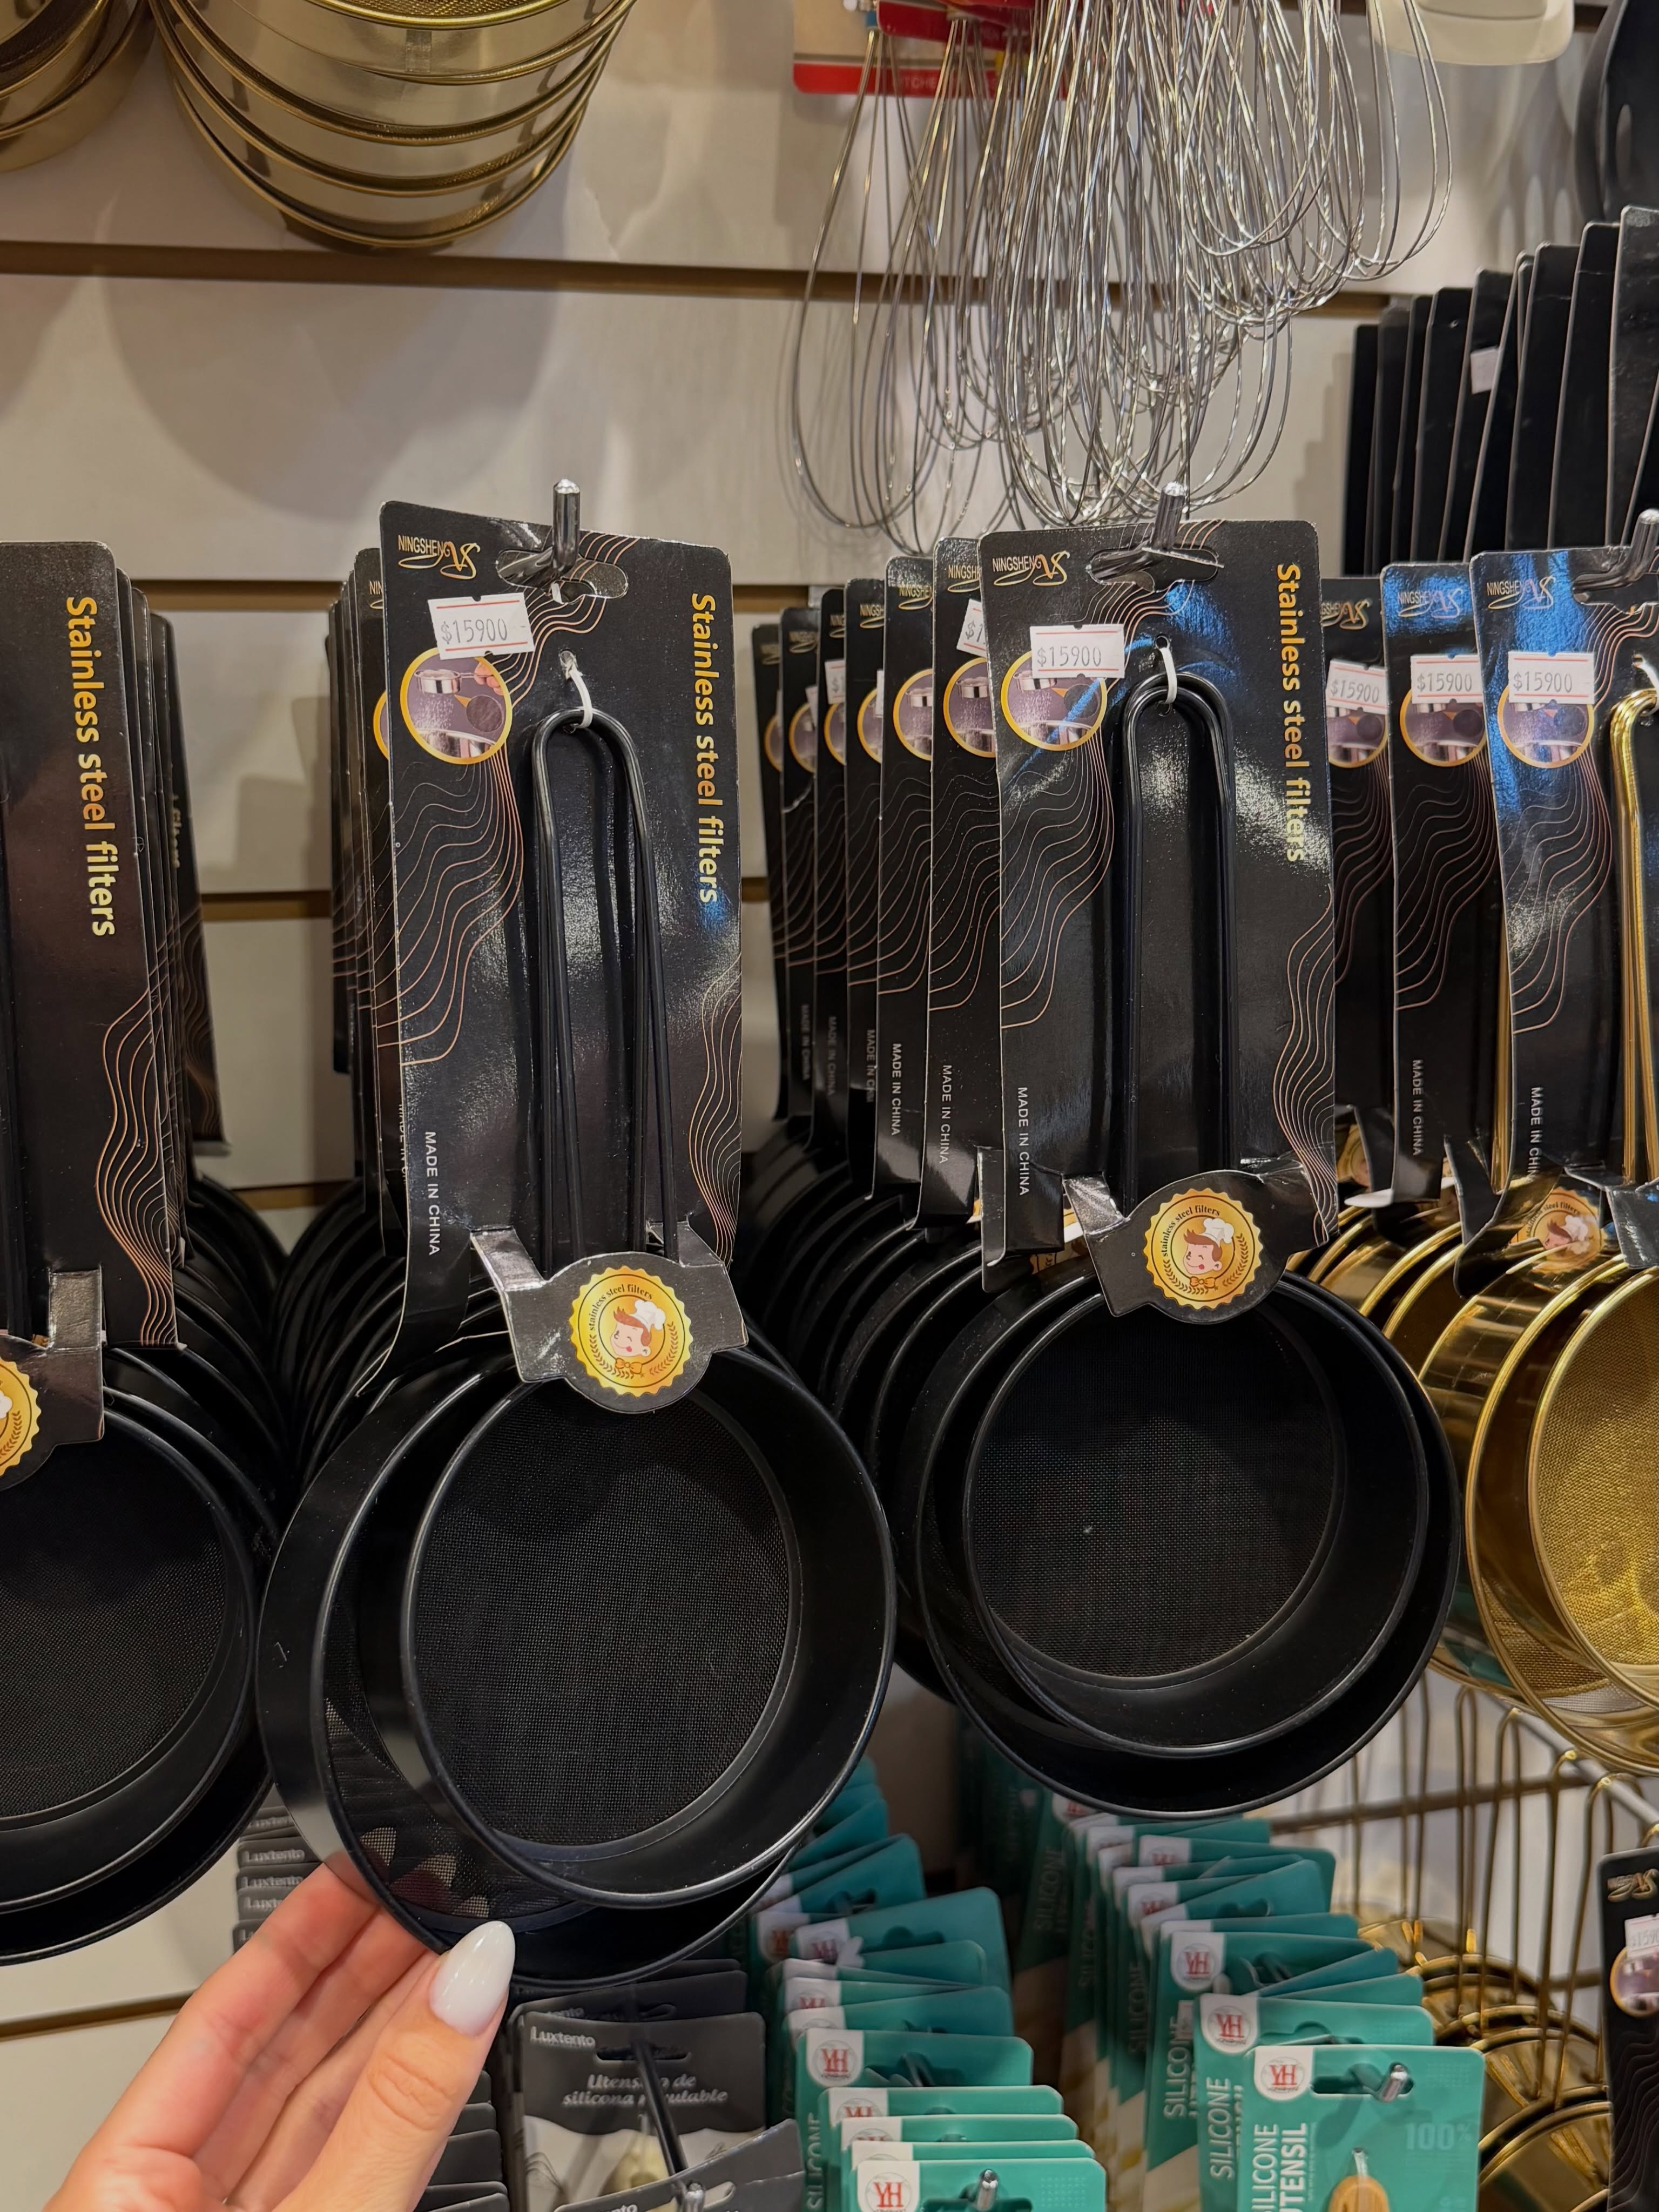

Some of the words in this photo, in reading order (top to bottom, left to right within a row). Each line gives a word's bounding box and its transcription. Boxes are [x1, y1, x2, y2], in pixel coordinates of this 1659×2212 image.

[397, 535, 451, 557] NINGSHENG
[992, 555, 1042, 572] NINGSHENG
[440, 618, 508, 645] $15900
[1277, 564, 1304, 691] Stainless
[66, 597, 105, 743] Stainless
[691, 594, 722, 725] Stainless
[1036, 645, 1102, 667] $15900
[1330, 678, 1380, 703] $15900
[1417, 672, 1473, 692] $15900
[1513, 671, 1573, 693] $15900
[1283, 700, 1310, 767] steel
[696, 735, 724, 806] steel
[78, 753, 115, 830] steel
[1285, 779, 1310, 863] filters
[698, 816, 724, 903] filters
[86, 842, 119, 936] filters
[866, 1029, 876, 1062] MADE
[892, 1043, 902, 1078] MADE
[866, 1065, 875, 1076] IN
[892, 1082, 901, 1095] IN
[941, 1064, 953, 1103] MADE
[1412, 1059, 1423, 1096] MADE
[891, 1097, 901, 1136] CHINA
[941, 1107, 951, 1120] IN
[1017, 1087, 1029, 1128] MADE
[1412, 1099, 1422, 1112] IN
[1530, 1087, 1542, 1126] MADE
[939, 1123, 951, 1164] CHINA
[1019, 1132, 1029, 1147] IN
[1412, 1116, 1423, 1156] CHINA
[1529, 1129, 1541, 1144] IN
[424, 1131, 439, 1178] MADE
[427, 1183, 440, 1199] IN
[1019, 1151, 1030, 1196] CHINA
[428, 1204, 441, 1256] CHINA
[1161, 1220, 1176, 1257] stainless
[1175, 1206, 1193, 1222] steel
[1195, 1204, 1221, 1217] filters
[588, 1294, 607, 1331] stainless
[606, 1284, 625, 1298] steel
[626, 1284, 653, 1300] filters
[529, 2026, 596, 2048] Luxtento
[1215, 2013, 1244, 2038] YH
[820, 2048, 848, 2073] YH
[1269, 2064, 1298, 2086] YH
[562, 2090, 635, 2107] silicona
[671, 2073, 698, 2088] de
[1205, 2076, 1236, 2180] SILICONE
[1251, 2123, 1279, 2212] ILICONE
[873, 2181, 903, 2208] YH
